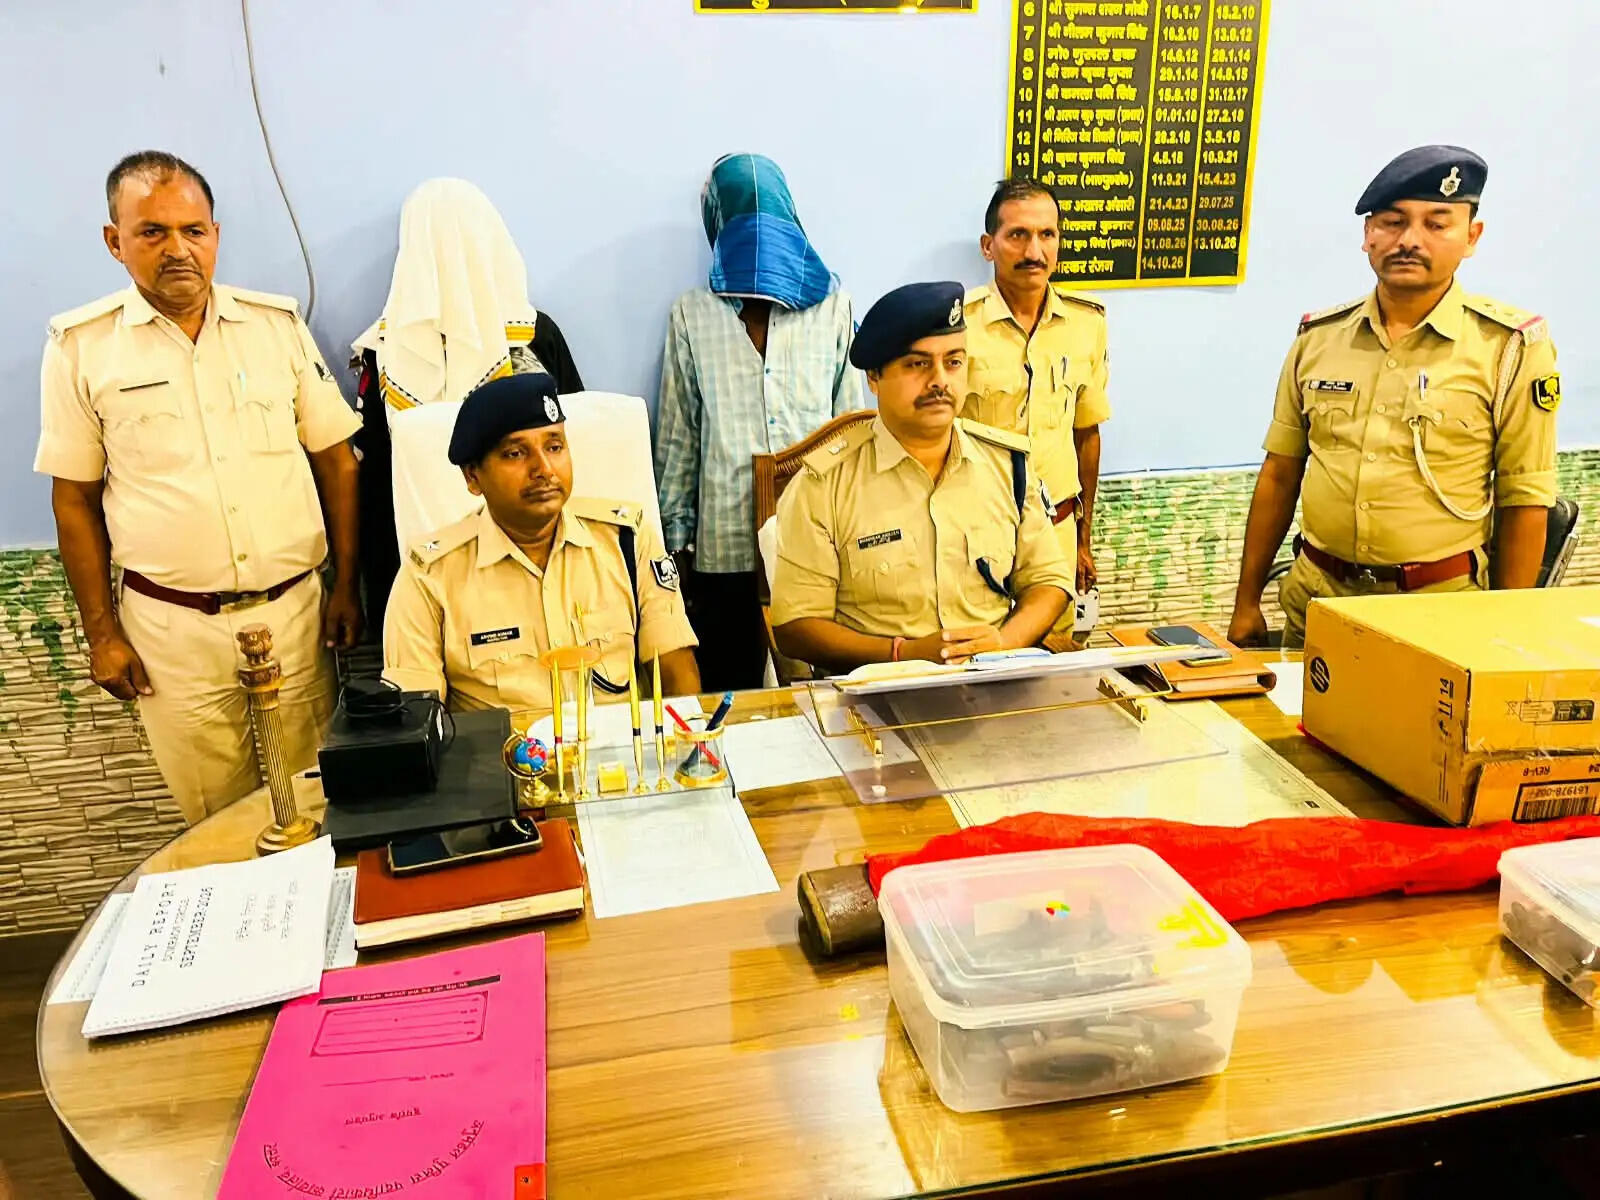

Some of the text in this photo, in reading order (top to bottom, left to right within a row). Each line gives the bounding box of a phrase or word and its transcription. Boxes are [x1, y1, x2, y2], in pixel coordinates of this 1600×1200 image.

[1024, 2, 1034, 16] 6
[1024, 26, 1034, 40] 7
[1024, 48, 1034, 62] 8
[1023, 67, 1033, 80] 9
[1019, 87, 1033, 101] 10
[1208, 87, 1248, 101] 31.12.17
[1018, 109, 1032, 124] 11
[1017, 131, 1031, 145] 12
[1016, 152, 1030, 166] 13
[1203, 150, 1238, 164] 10.9.21
[1151, 173, 1187, 186] 11.9.21
[1150, 197, 1188, 210] 21.4.23
[1199, 196, 1234, 209] 29.07.25
[1147, 218, 1185, 231] 09.08.25
[131, 882, 177, 988] DAILY REPORT
[409, 1157, 450, 1185] पुलिस
